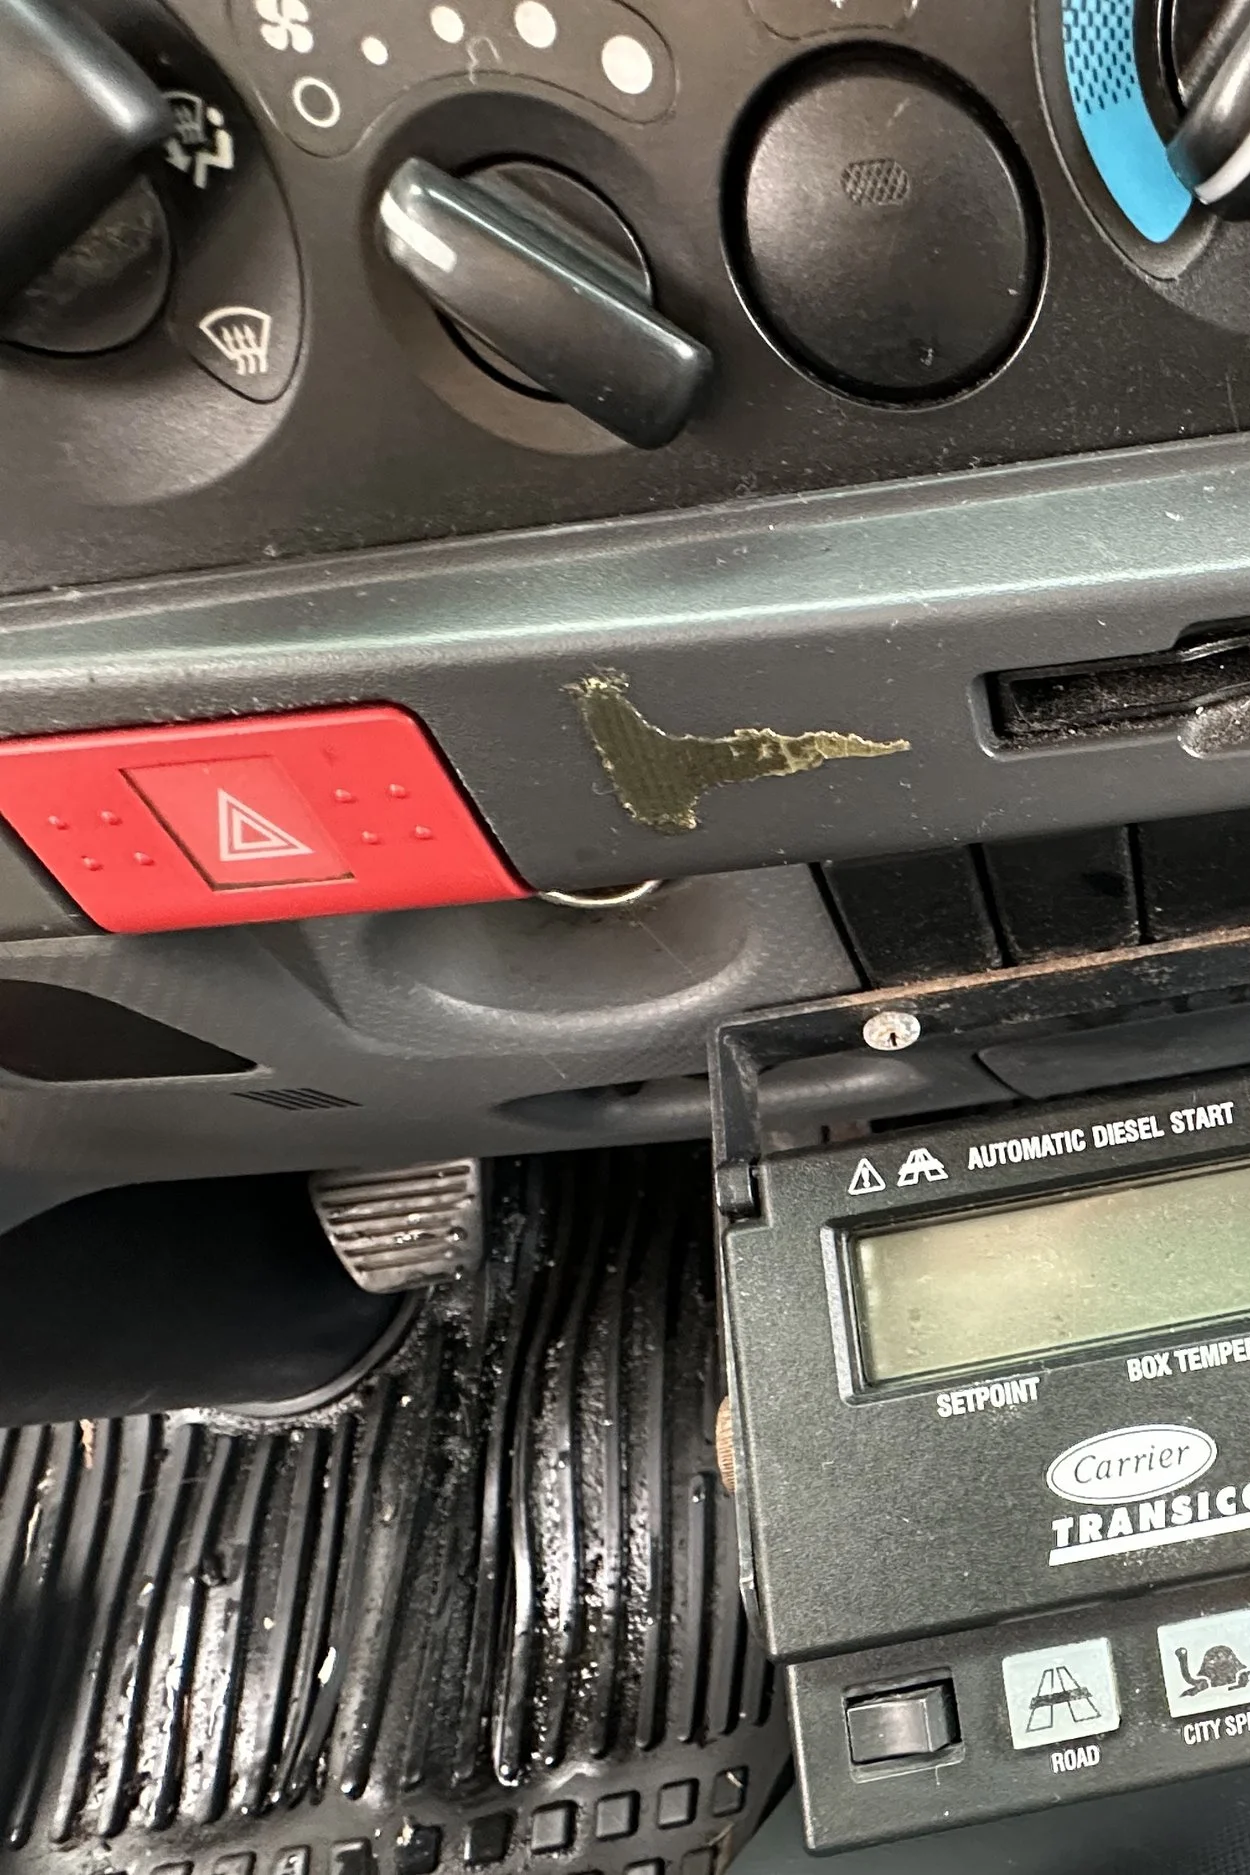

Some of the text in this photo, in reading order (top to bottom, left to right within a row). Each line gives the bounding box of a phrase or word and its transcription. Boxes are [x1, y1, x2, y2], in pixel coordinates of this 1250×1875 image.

[967, 1102, 1234, 1170] AUTOMATIC DIESEL START
[1127, 1354, 1174, 1382] BOX
[936, 1378, 1040, 1418] SETPOINT
[1073, 1443, 1191, 1484] Carrier
[1183, 1721, 1222, 1745] CITY
[1051, 1745, 1101, 1773] ROAD
